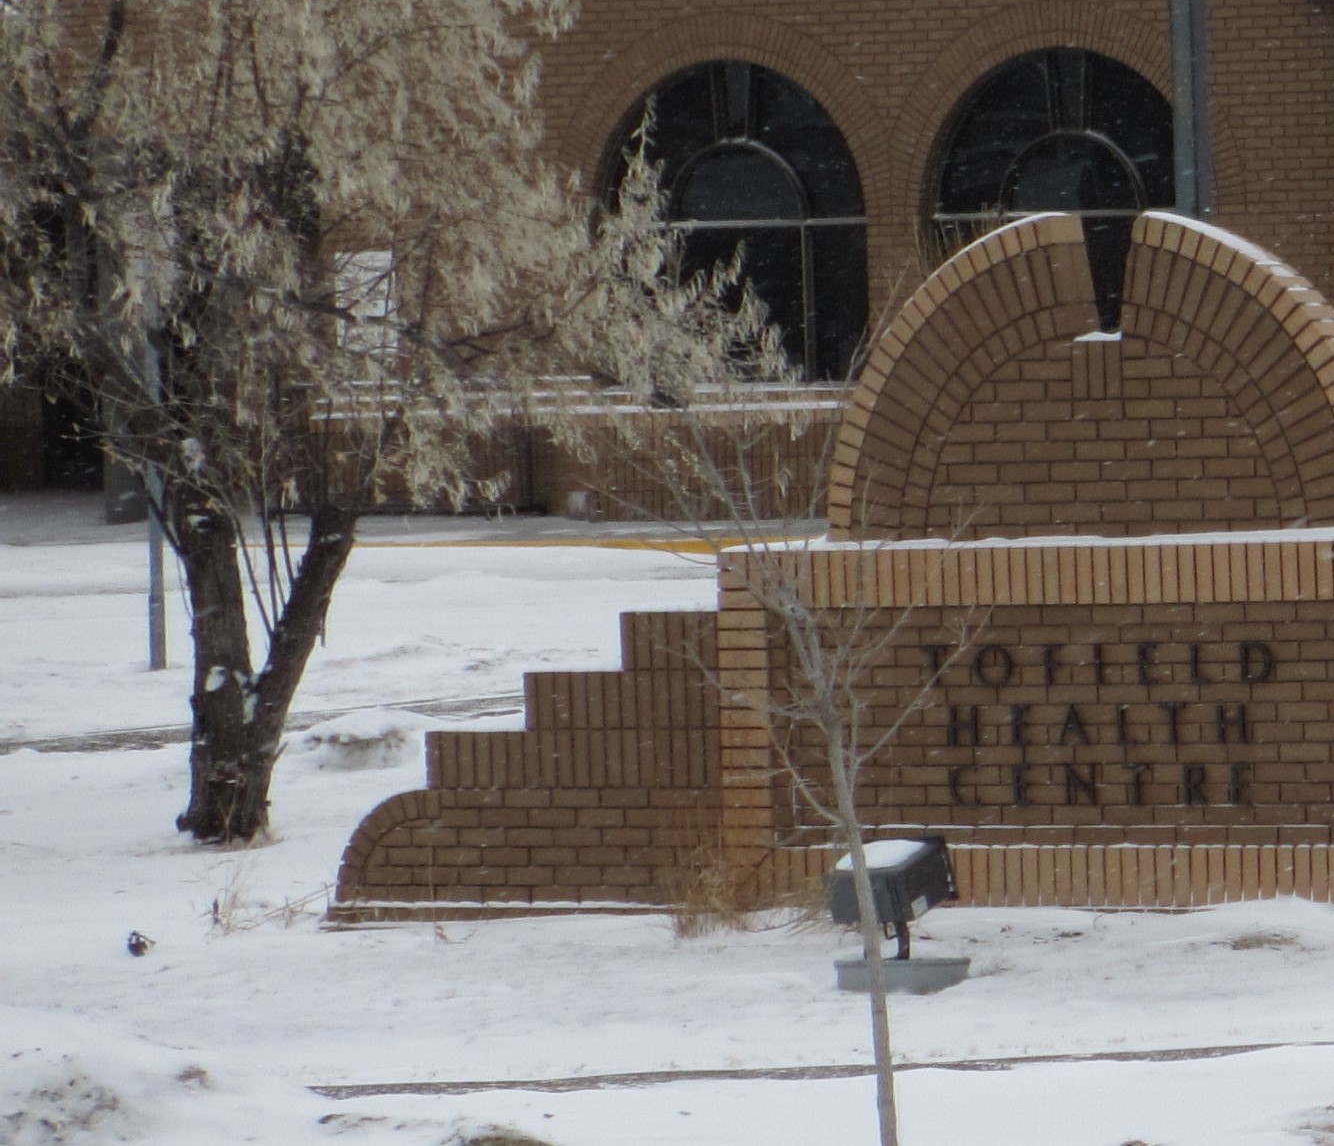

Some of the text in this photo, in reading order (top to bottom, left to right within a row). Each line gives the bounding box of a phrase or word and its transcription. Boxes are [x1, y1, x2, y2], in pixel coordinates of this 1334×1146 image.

[921, 640, 1274, 688] TOFIELD
[948, 702, 1251, 747] HEALTH
[948, 762, 1254, 807] CENTRE
